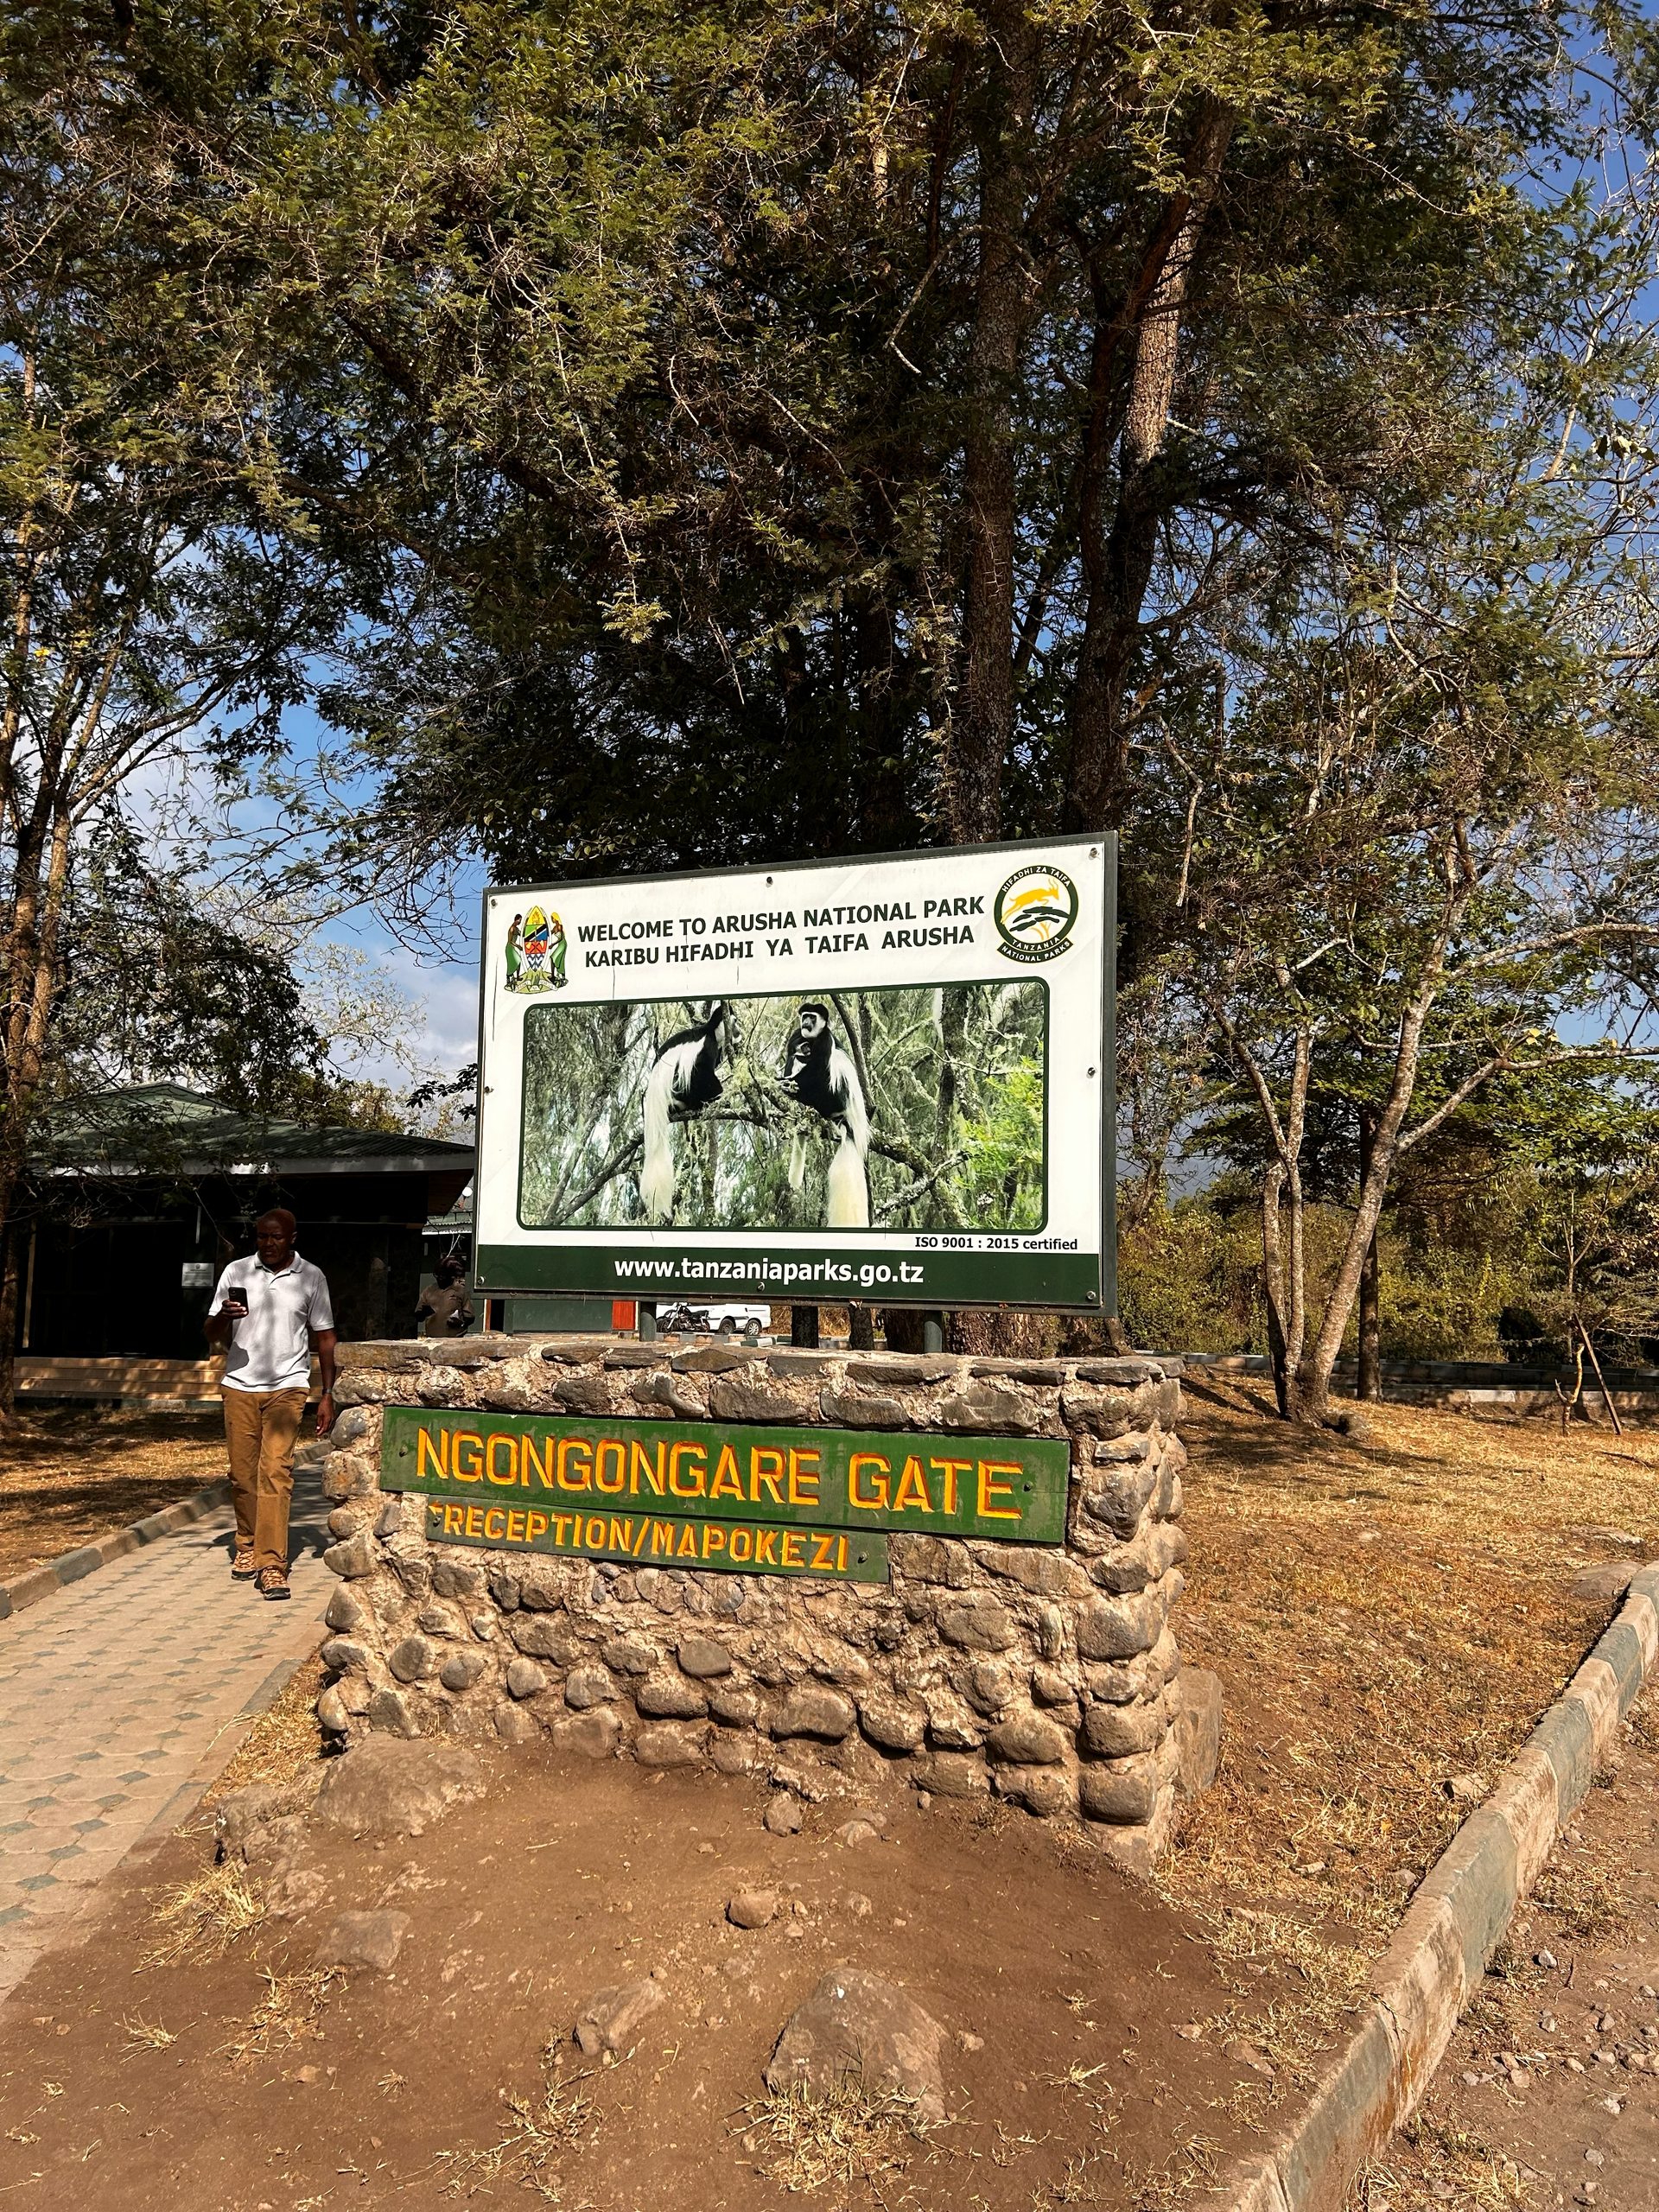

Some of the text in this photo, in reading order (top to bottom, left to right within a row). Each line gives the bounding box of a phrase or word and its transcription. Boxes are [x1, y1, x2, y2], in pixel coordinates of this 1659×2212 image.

[1001, 867, 1033, 893] HIFADHI
[1051, 868, 1071, 887] TAIFA
[577, 895, 985, 943] WELCOME TO ARUSHA NATIONAL PARK
[585, 925, 975, 968] KARIBU HIFADHI YA TAIFA ARUSHA
[1001, 941, 1071, 962] NATIONAL PARKS
[1012, 936, 1060, 950] TANZANIA
[914, 1236, 938, 1248] ISO
[942, 1236, 974, 1249] 9001
[986, 1237, 1020, 1249] 2015
[1022, 1238, 1077, 1250] certified
[614, 1256, 924, 1287] www.tanzaniaparks.go.tz
[416, 1427, 1025, 1521] NGONGONGARE GATE
